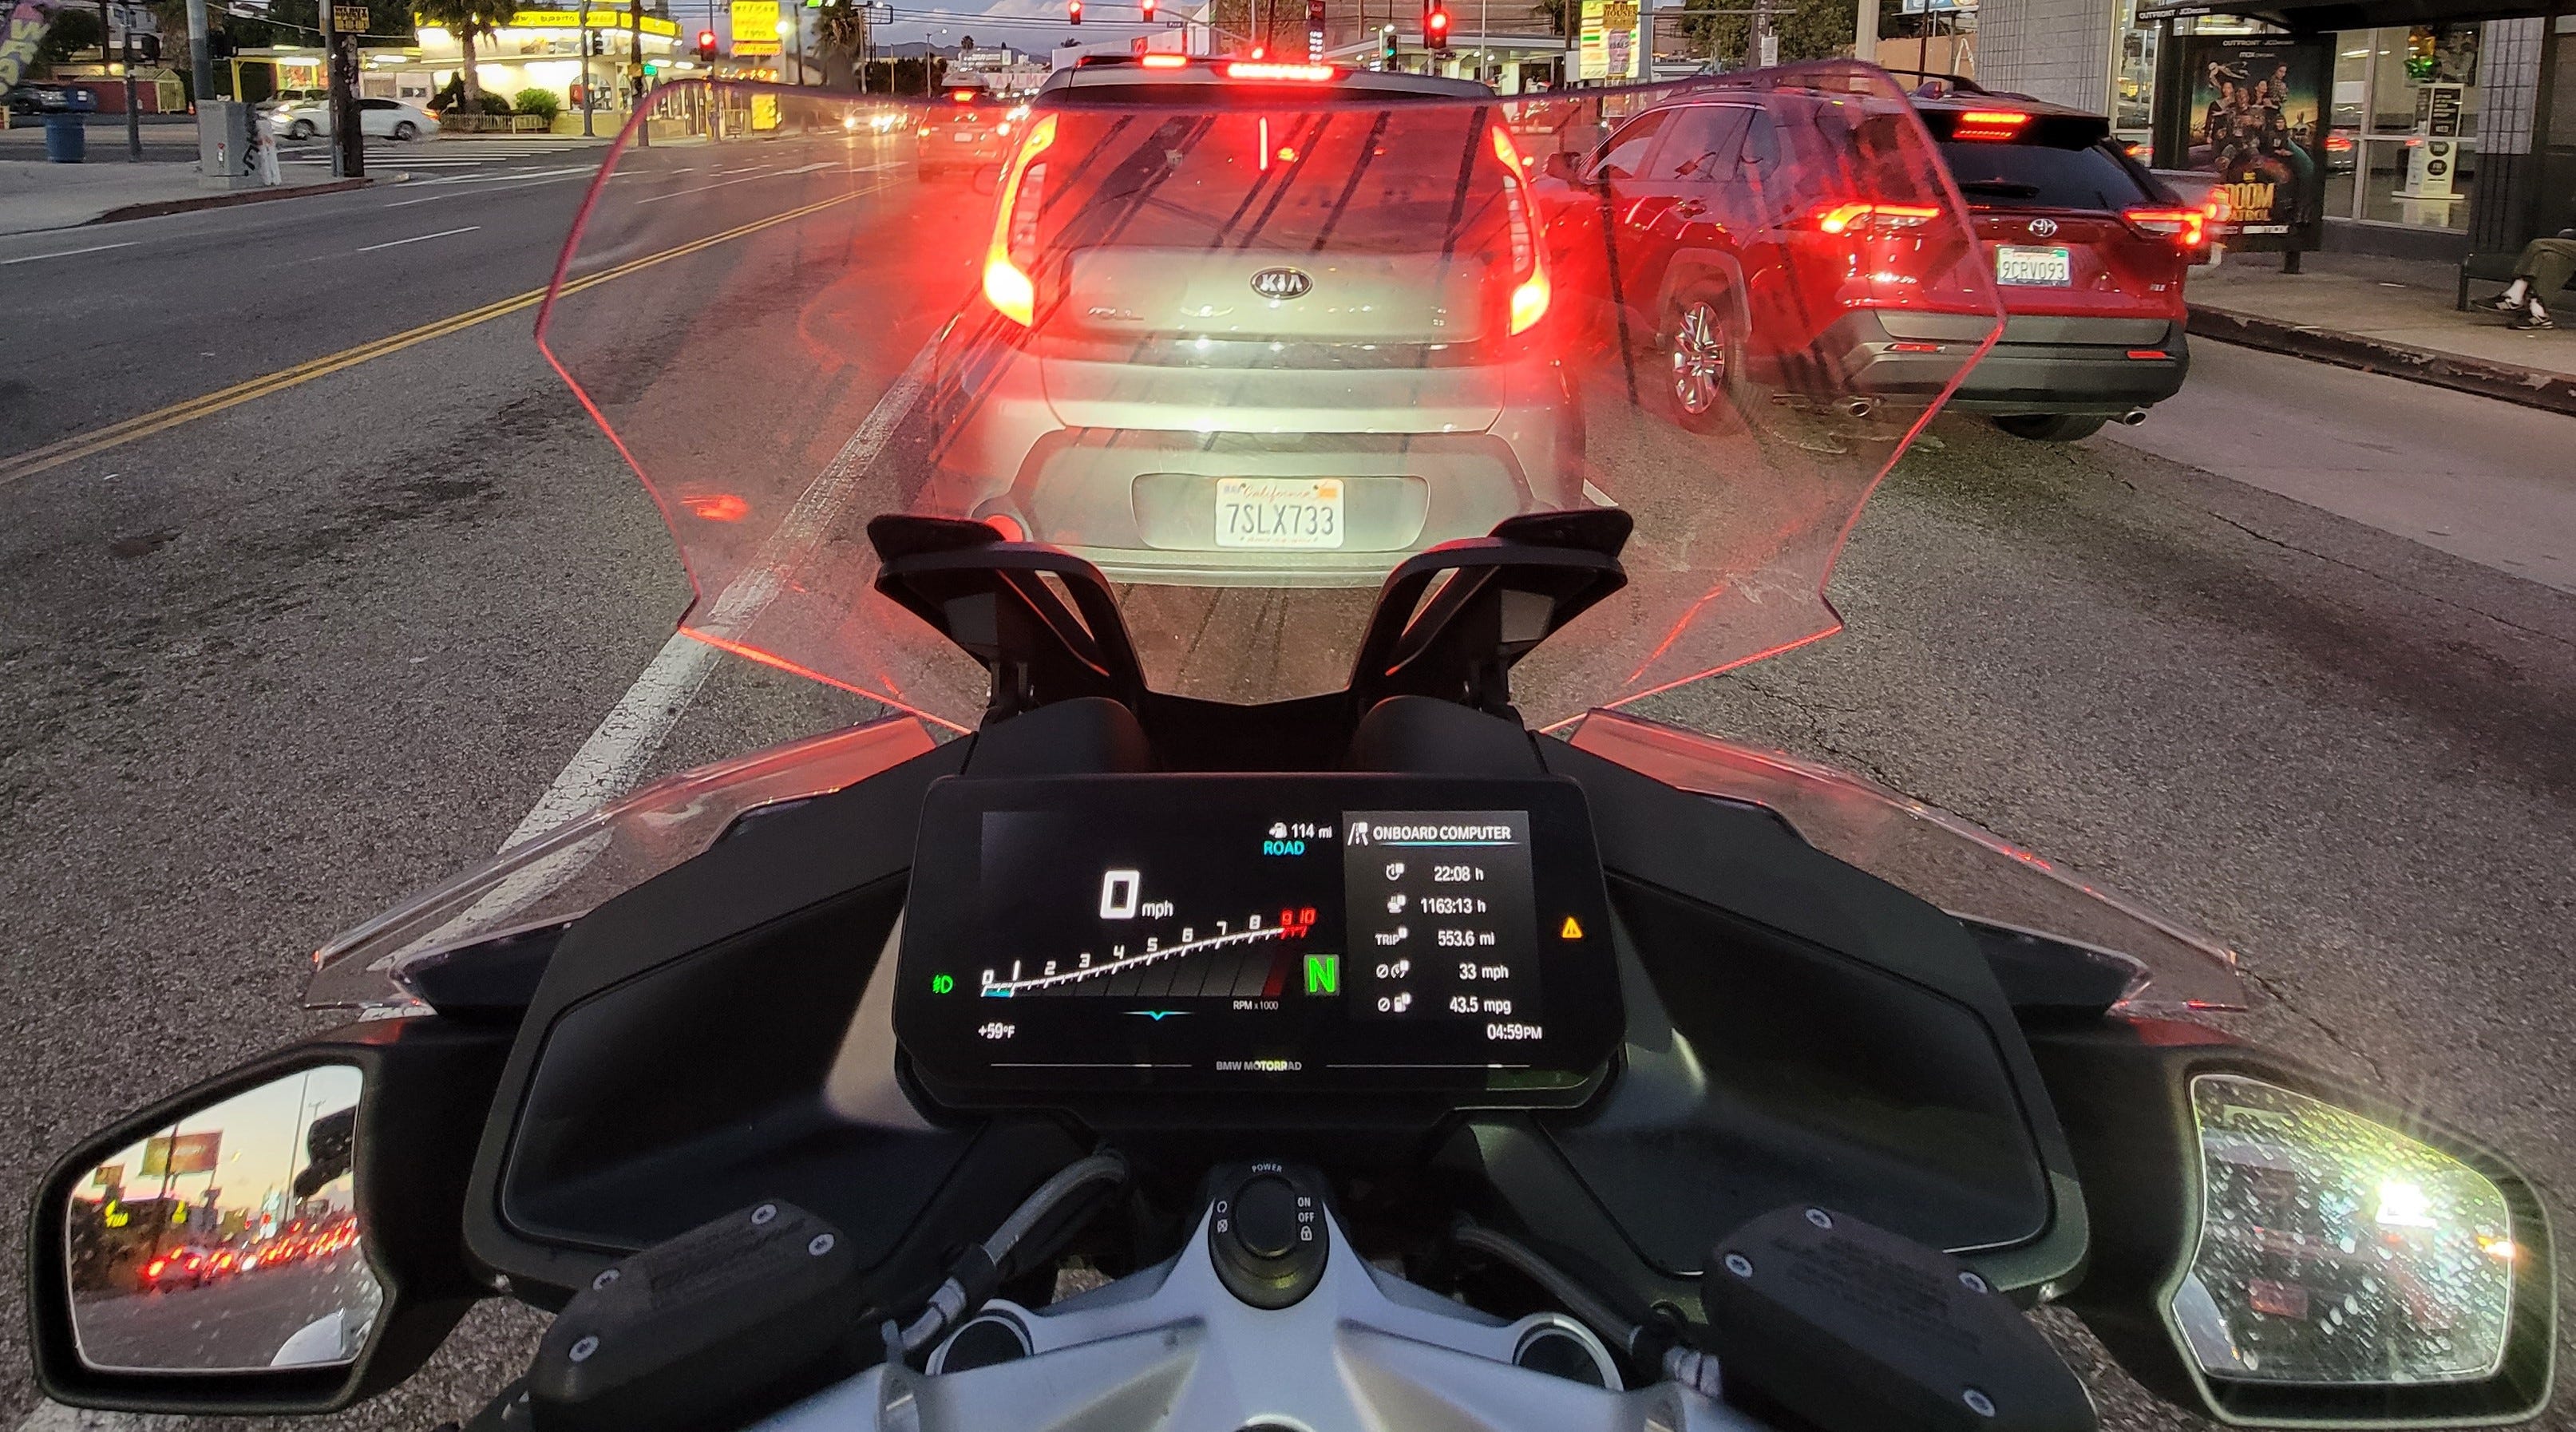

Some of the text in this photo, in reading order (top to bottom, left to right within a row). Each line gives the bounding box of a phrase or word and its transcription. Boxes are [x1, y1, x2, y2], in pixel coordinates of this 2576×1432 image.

[2139, 10, 2175, 19] OUTFRONT
[2001, 260, 2065, 280] 9CRV093
[1260, 273, 1304, 293] KIA
[1225, 503, 1334, 536] 7SLX733
[1291, 823, 1315, 838] 114
[1372, 825, 1511, 841] ONBOARD COMPUTER
[1263, 840, 1305, 856] ROAD
[1434, 865, 1484, 882] 22:08 h
[1099, 869, 1174, 920] 0 mph
[1420, 897, 1486, 915] 1163:13 h
[981, 908, 1316, 985] 0 1 2 3 4 5 6 7 8 9 10
[1375, 933, 1400, 946] TRIP
[1438, 930, 1475, 947] 553.6
[1308, 956, 1336, 993] N
[1458, 963, 1510, 982] 33 mph
[1233, 999, 1252, 1011] RPM
[1449, 995, 1512, 1015] 43.5 mpg
[1216, 1060, 1302, 1072] BMW MOTORRAD
[1252, 1163, 1282, 1173] POWER
[1297, 1197, 1311, 1208] ON
[1298, 1212, 1315, 1224] OFF
